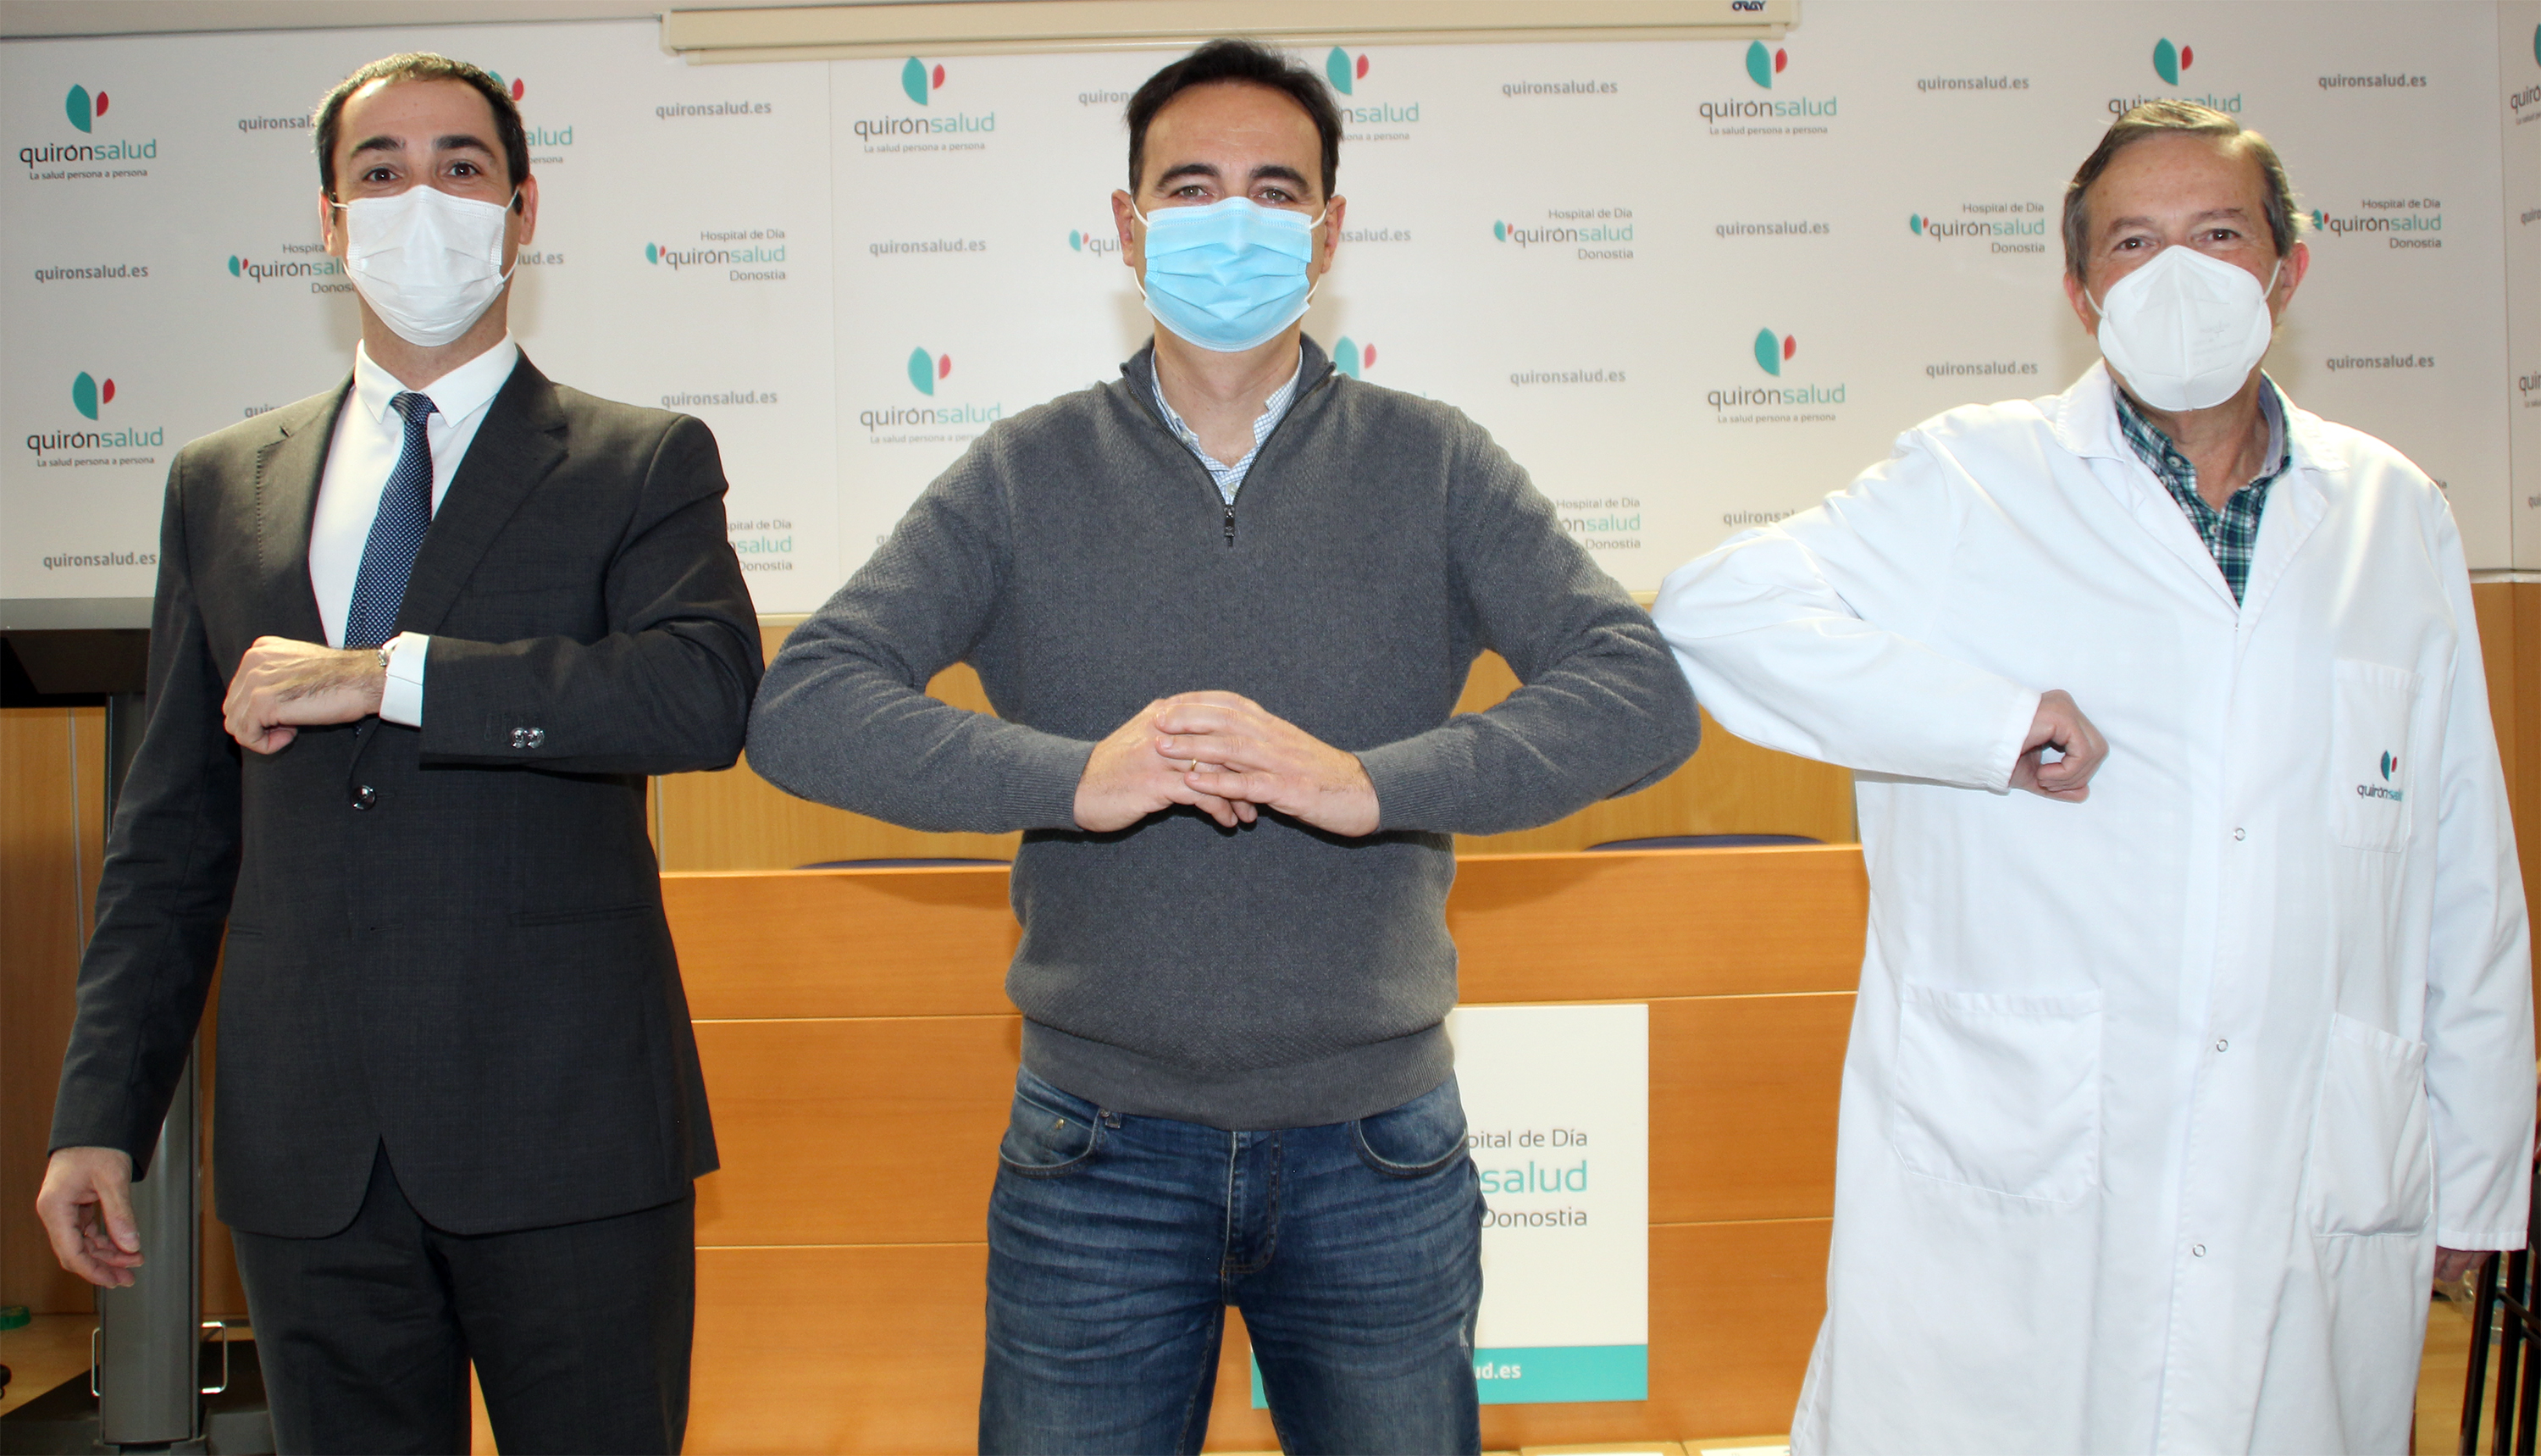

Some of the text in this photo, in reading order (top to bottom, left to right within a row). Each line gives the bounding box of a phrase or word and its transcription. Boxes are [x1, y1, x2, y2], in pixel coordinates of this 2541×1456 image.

[1502, 80, 1619, 97] quironsalud.es
[1918, 76, 2029, 93] quironsalud.es
[2318, 74, 2427, 91] quironsalud.es
[656, 101, 772, 119] quironsalud.es
[1340, 102, 1420, 124] nsalud
[1699, 97, 1838, 125] quirónsalud
[238, 115, 314, 133] quironsal
[854, 112, 995, 141] quirónsalud
[1722, 126, 1745, 135] salud
[1747, 126, 1783, 136] persona
[1792, 125, 1828, 135] persona
[1374, 132, 1410, 141] persona
[19, 139, 157, 169] quirónsalud
[876, 144, 900, 152] salud
[902, 144, 938, 153] persona
[949, 142, 986, 151] persona
[42, 170, 65, 179] salud
[67, 170, 102, 180] persona
[113, 169, 148, 178] persona
[1962, 203, 2008, 214] Hospital
[2011, 203, 2023, 212] de
[2362, 199, 2405, 210] Hospital
[2408, 199, 2421, 208] de
[1548, 209, 1595, 220] Hospital
[1597, 208, 1611, 218] de
[1716, 220, 1830, 238] quironsalud.es
[1929, 218, 2046, 242] quirónsalud
[2329, 213, 2442, 237] quirónsalud
[700, 230, 747, 241] Hospital
[750, 230, 764, 239] de
[1514, 223, 1634, 248] quirónsalud
[2389, 237, 2442, 249] Donostia
[283, 244, 325, 254] Hospita
[869, 238, 987, 257] quironsalud.es
[1577, 248, 1634, 260] Donostia
[1991, 242, 2046, 253] Donostia
[666, 245, 785, 271] quirónsalud
[35, 264, 149, 283] quironsalud.es
[248, 257, 346, 283] quirónsal
[729, 269, 786, 281] Donostia
[312, 282, 356, 293] Donos
[1926, 361, 2038, 379] quironsalud.es
[2327, 355, 2435, 372] quironsalud.es
[1510, 368, 1626, 386] quironsalud.es
[661, 390, 778, 408] quironsalud.es
[1708, 383, 1846, 412] quirónsalud
[1718, 415, 1727, 424] La
[1730, 414, 1753, 423] salud
[1755, 414, 1791, 424] persona
[1801, 413, 1836, 423] persona
[27, 426, 163, 457] quirónsalud
[870, 435, 880, 444] La
[883, 435, 906, 443] salud
[909, 435, 944, 444] persona
[48, 458, 72, 467] salud
[75, 458, 109, 468] persona
[119, 457, 154, 466] persona
[1556, 499, 1603, 510] Hospital
[1605, 499, 1619, 508] de
[728, 520, 754, 532] pital
[756, 520, 770, 529] de
[1585, 538, 1641, 550] Donostia
[43, 552, 157, 570] quironsalud.es
[1469, 1129, 1587, 1149] pital de Día
